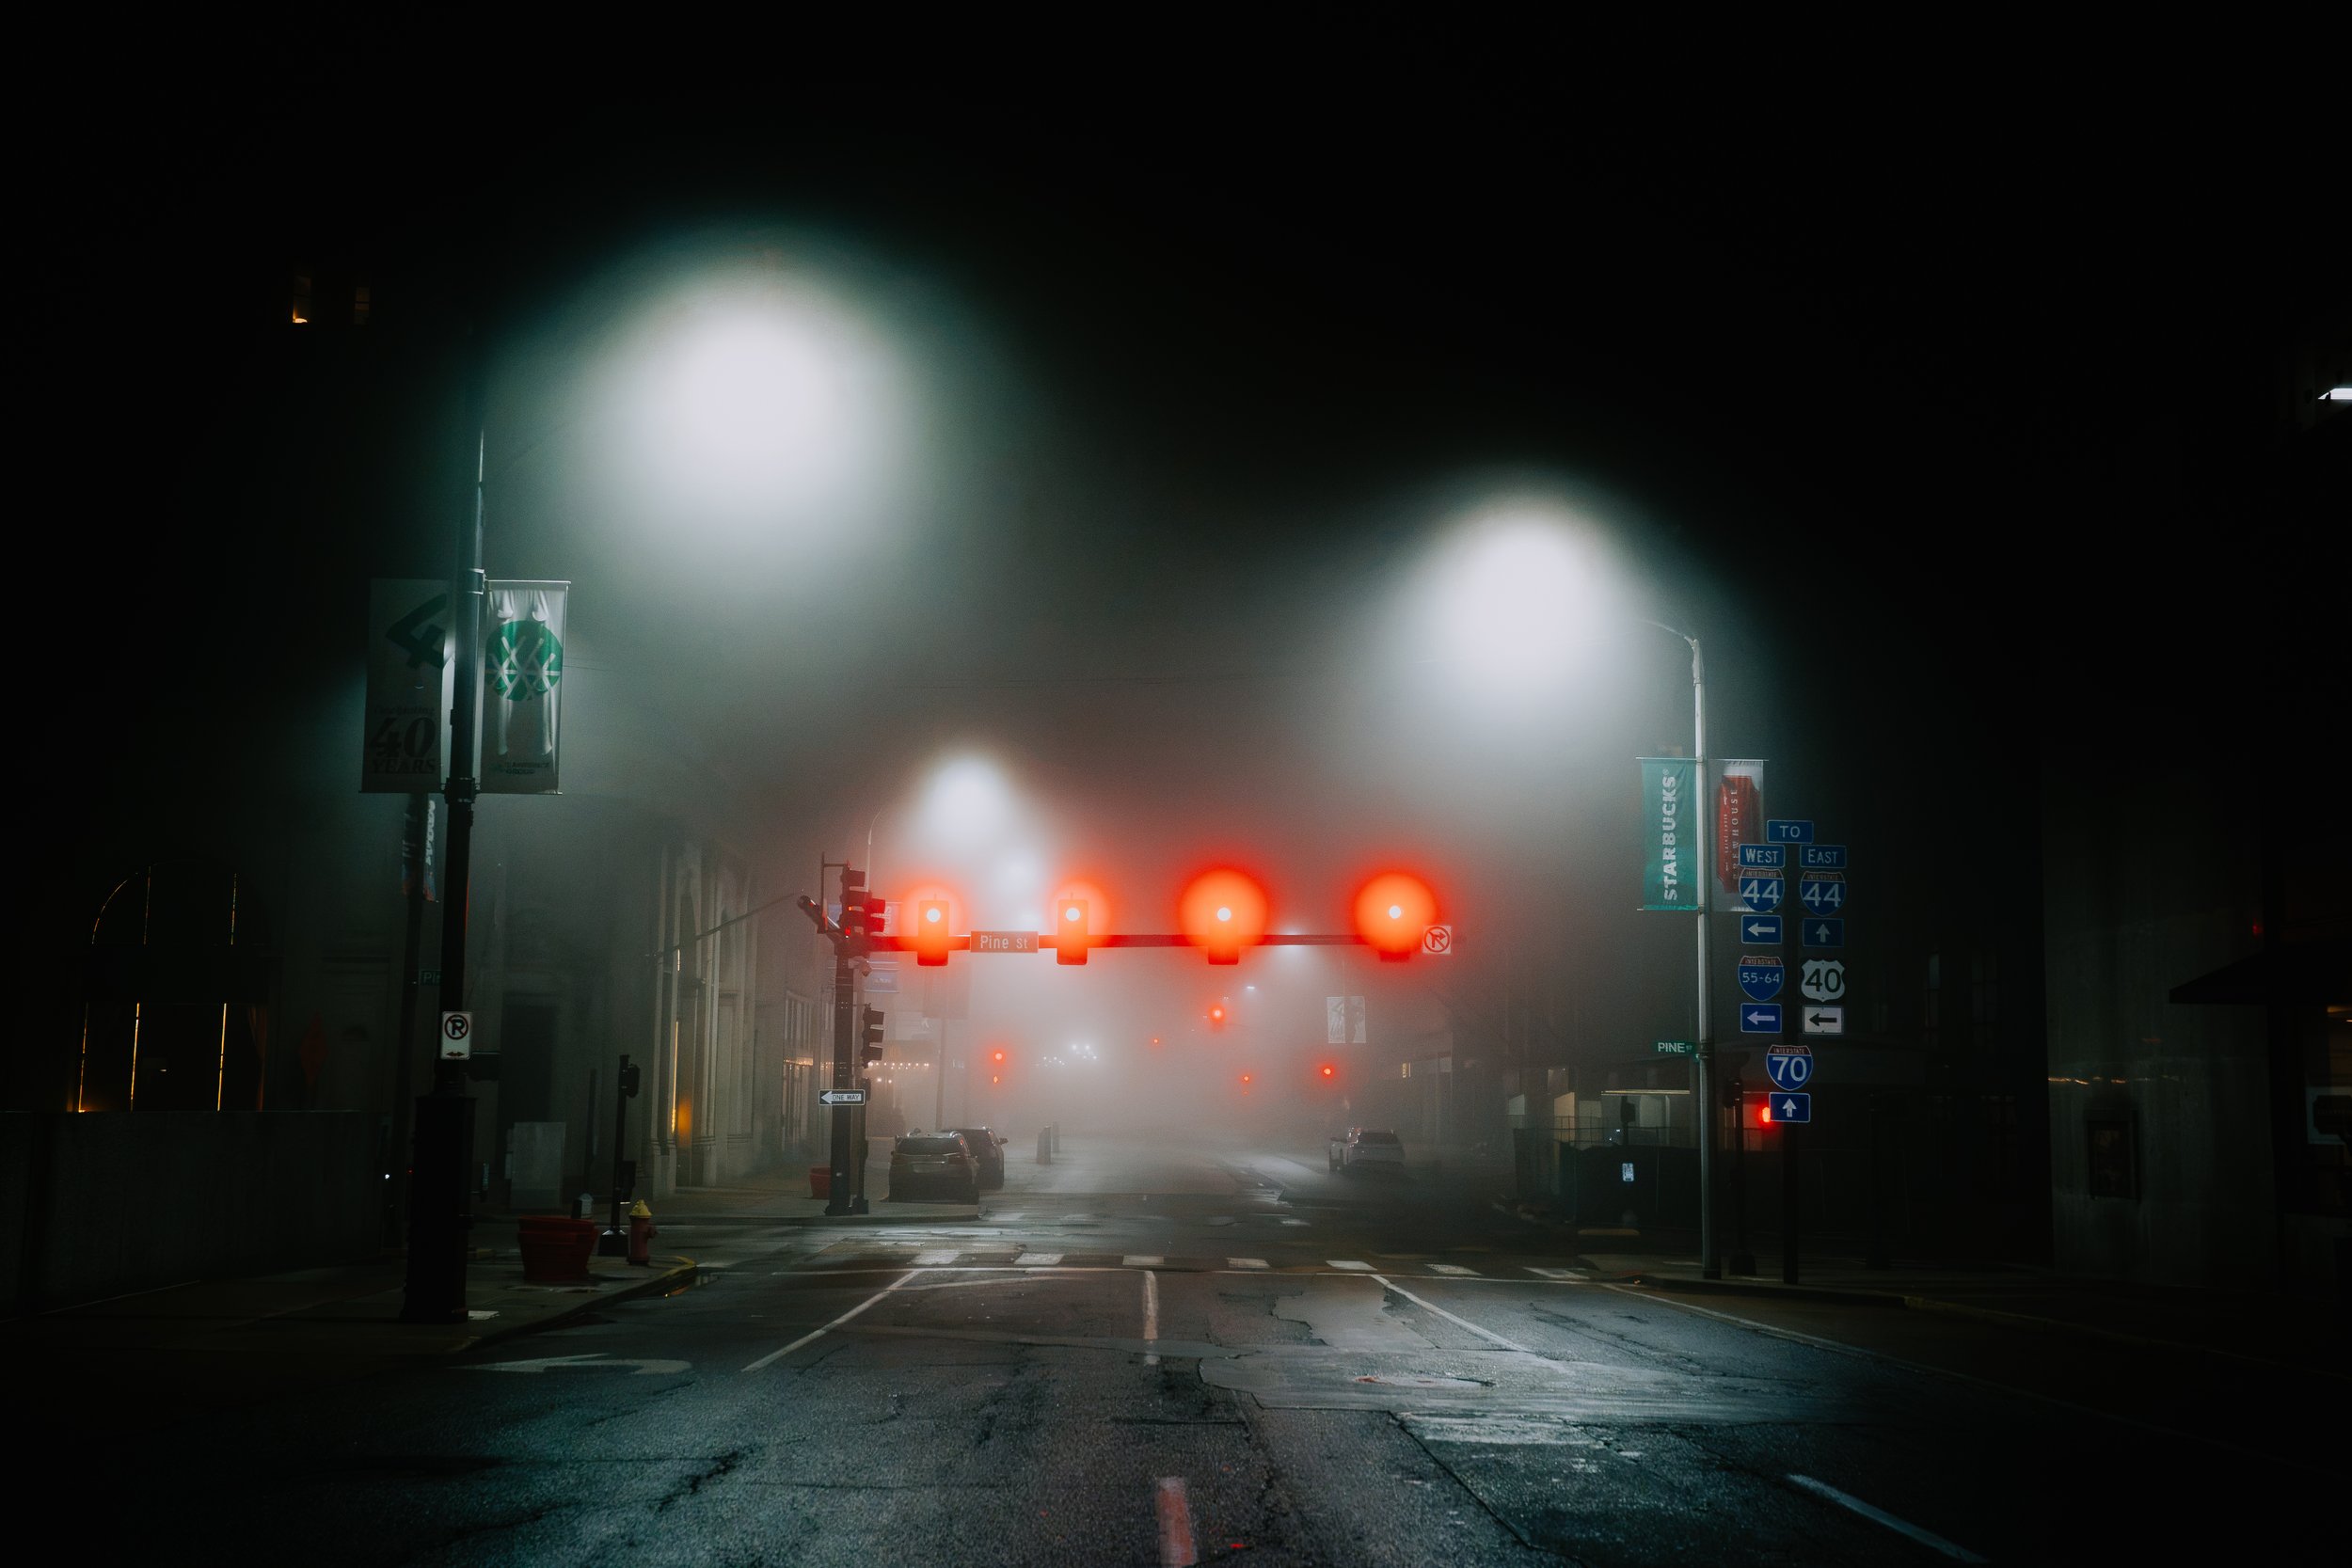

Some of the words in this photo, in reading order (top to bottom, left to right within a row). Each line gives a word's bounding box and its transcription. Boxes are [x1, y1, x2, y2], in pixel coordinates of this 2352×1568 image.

[369, 717, 437, 758] 40
[370, 758, 437, 774] YEARS
[1662, 776, 1677, 901] STARBUCKS
[1778, 825, 1801, 839] TO
[1745, 847, 1779, 864] WEST
[1807, 848, 1839, 864] EAST
[1741, 879, 1780, 904] 44
[1803, 882, 1842, 908] 44
[979, 934, 1009, 949] Pine
[1742, 973, 1780, 984] 55-64
[1804, 968, 1841, 993] 40
[1658, 1042, 1686, 1053] PINE
[1772, 1056, 1807, 1082] 70
